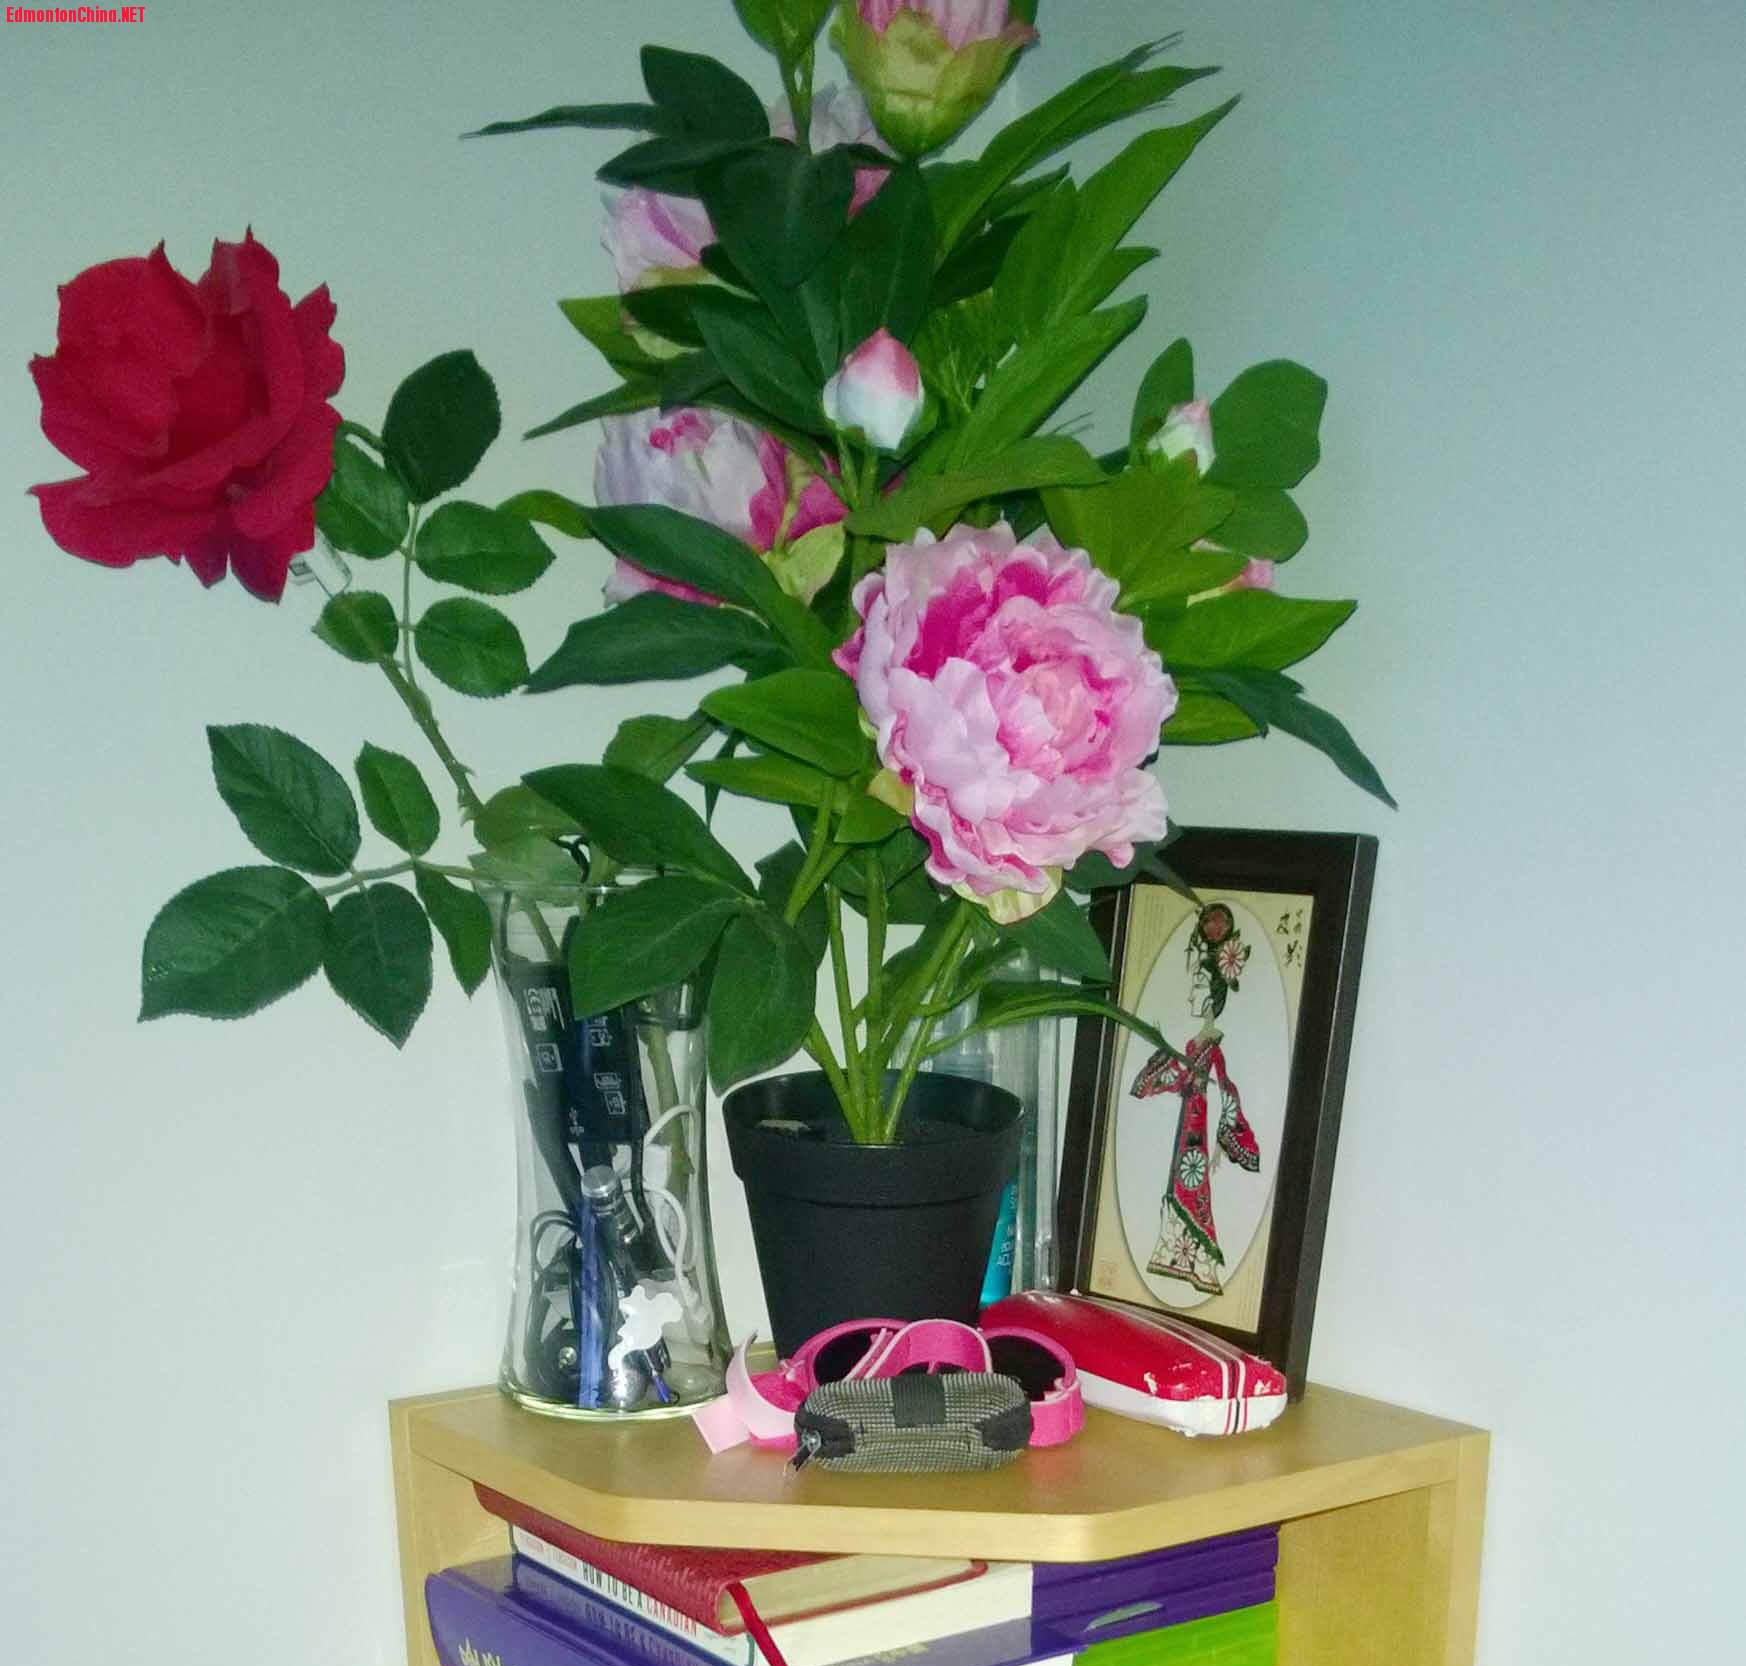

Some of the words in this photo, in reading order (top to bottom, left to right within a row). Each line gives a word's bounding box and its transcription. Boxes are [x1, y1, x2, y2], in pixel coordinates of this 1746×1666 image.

[582, 1562, 602, 1588] HOW
[607, 1571, 619, 1597] TO
[644, 1591, 698, 1636] CANADIAN
